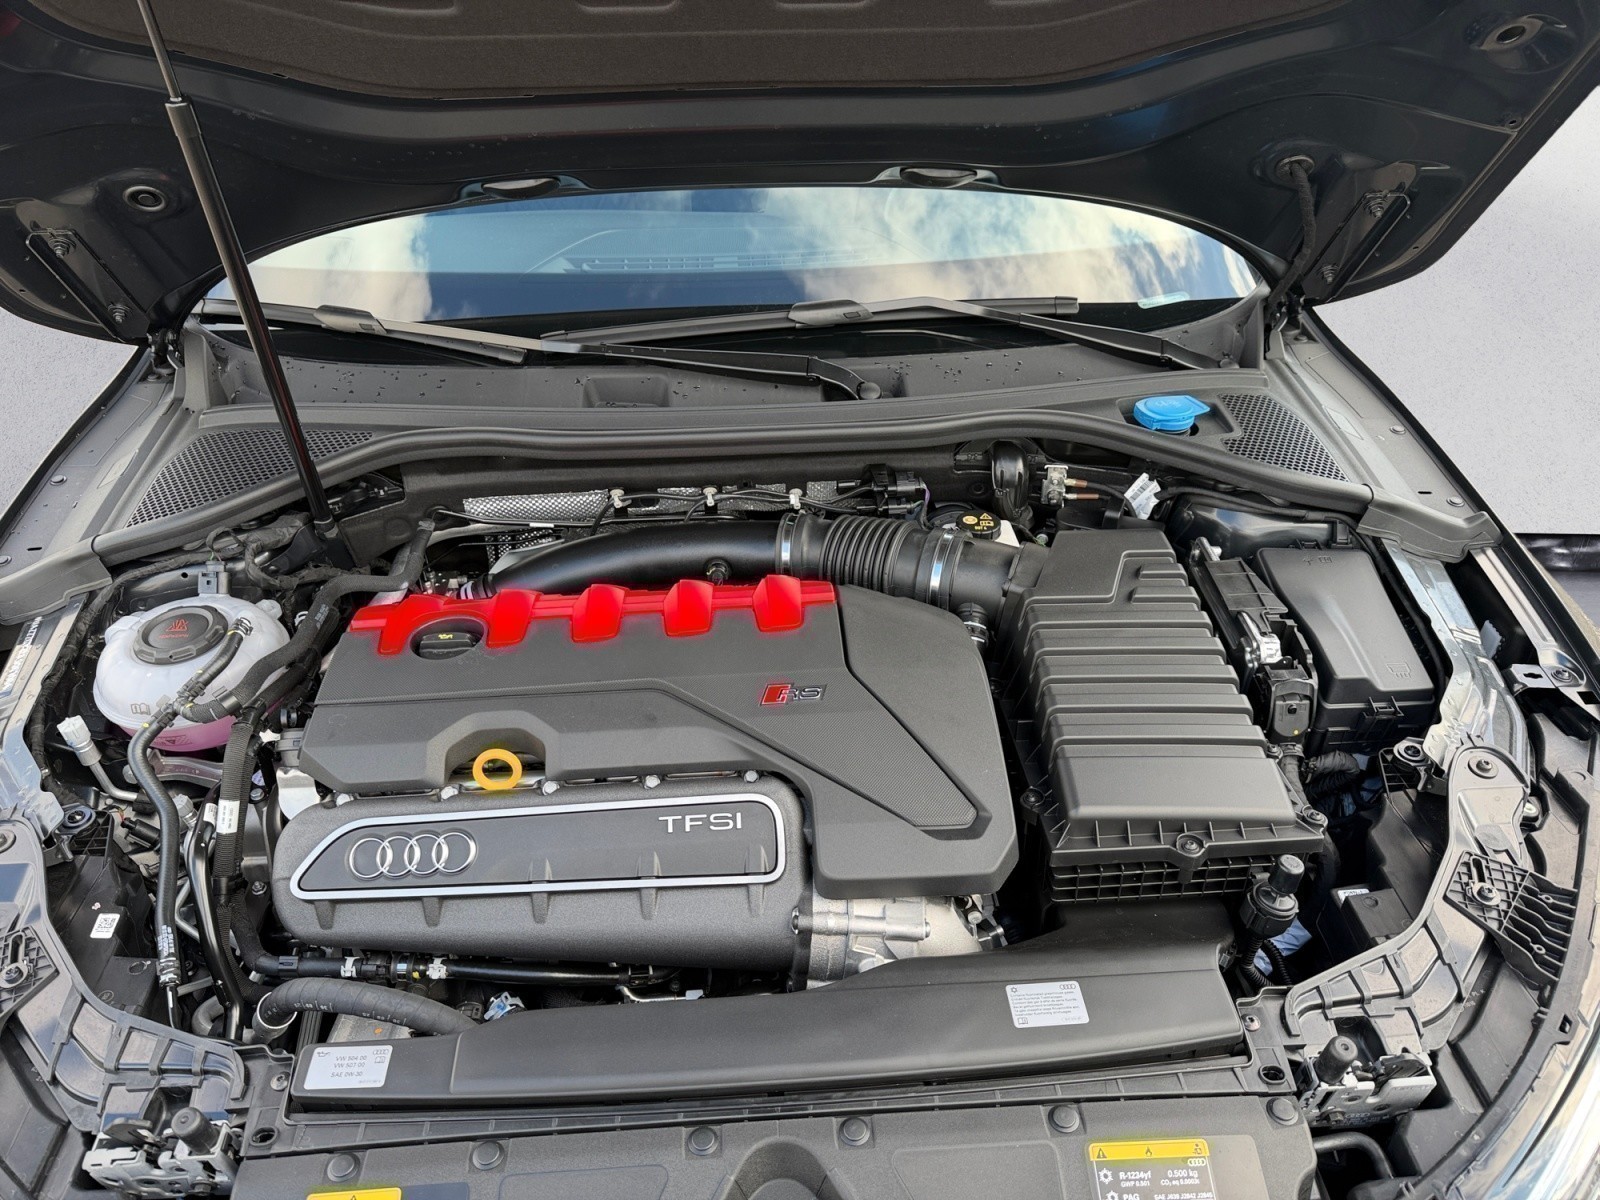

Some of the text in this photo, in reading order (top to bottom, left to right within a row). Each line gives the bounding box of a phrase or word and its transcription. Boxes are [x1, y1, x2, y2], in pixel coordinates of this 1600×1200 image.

[770, 685, 823, 702] RS
[659, 812, 742, 833] TFSI
[1119, 1170, 1152, 1180] R-1234yf
[1167, 1169, 1198, 1178] 0.500 kg
